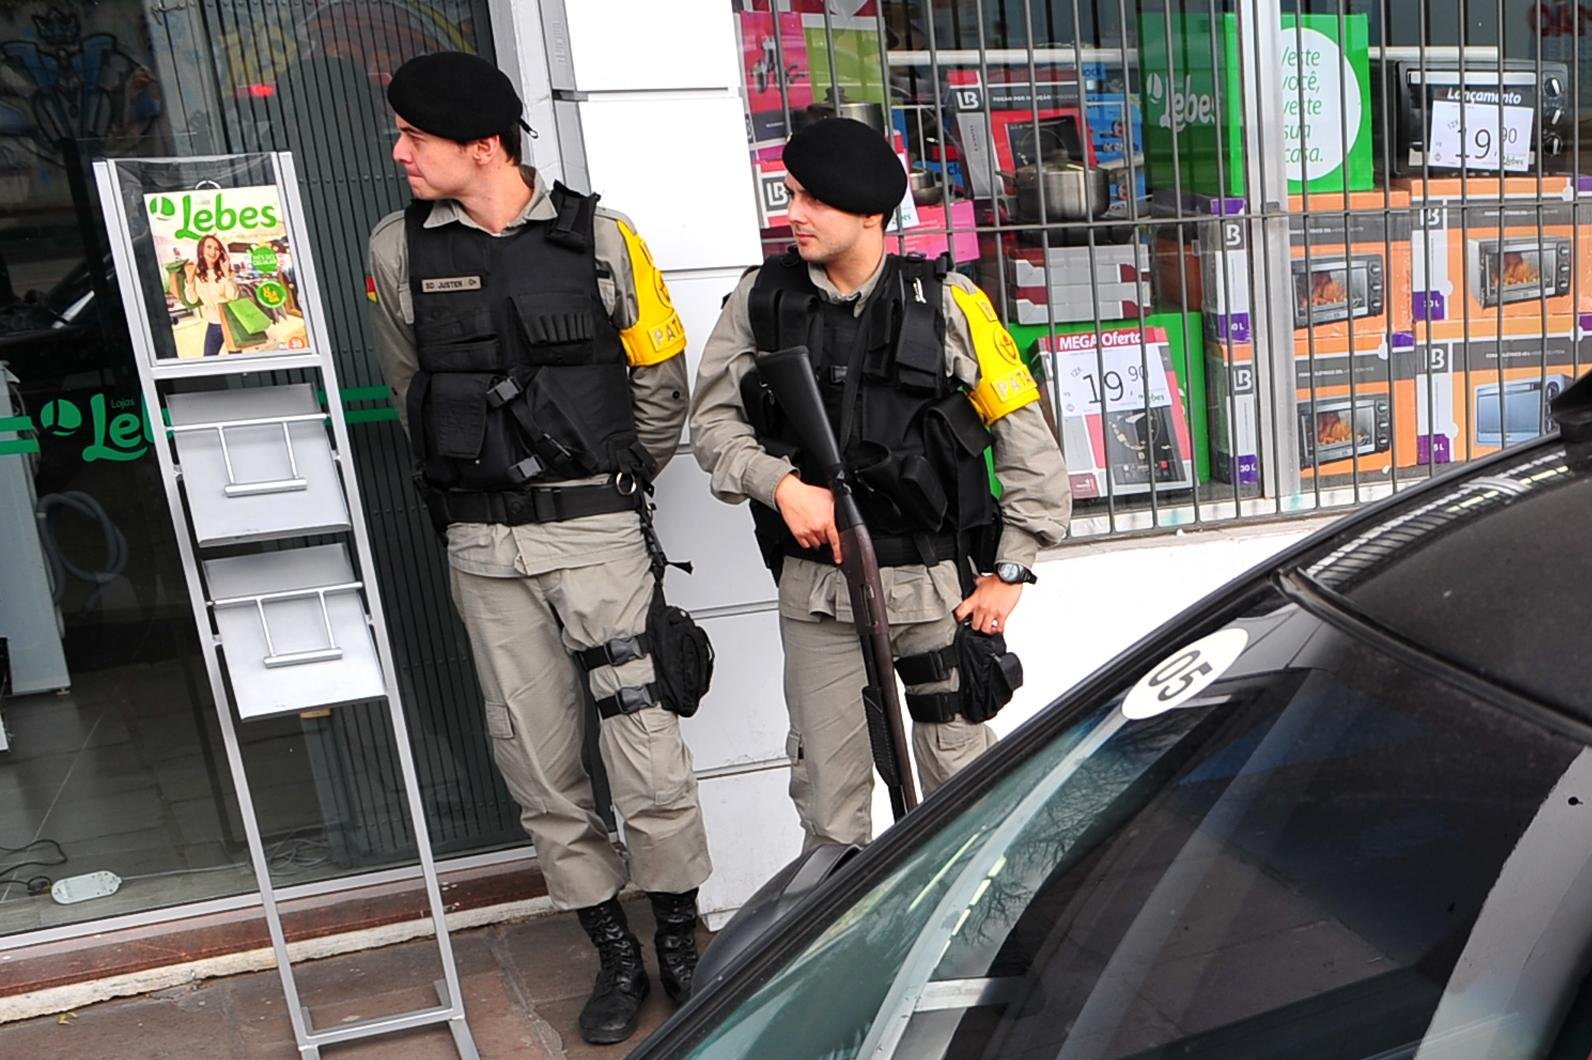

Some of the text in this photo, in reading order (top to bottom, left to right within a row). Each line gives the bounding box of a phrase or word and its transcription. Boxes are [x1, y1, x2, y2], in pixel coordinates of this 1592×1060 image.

[1281, 45, 1321, 66] ete
[1283, 98, 1322, 115] ete
[174, 193, 278, 241] Lebes
[1059, 334, 1098, 351] MEGA
[1148, 650, 1214, 702] 05
